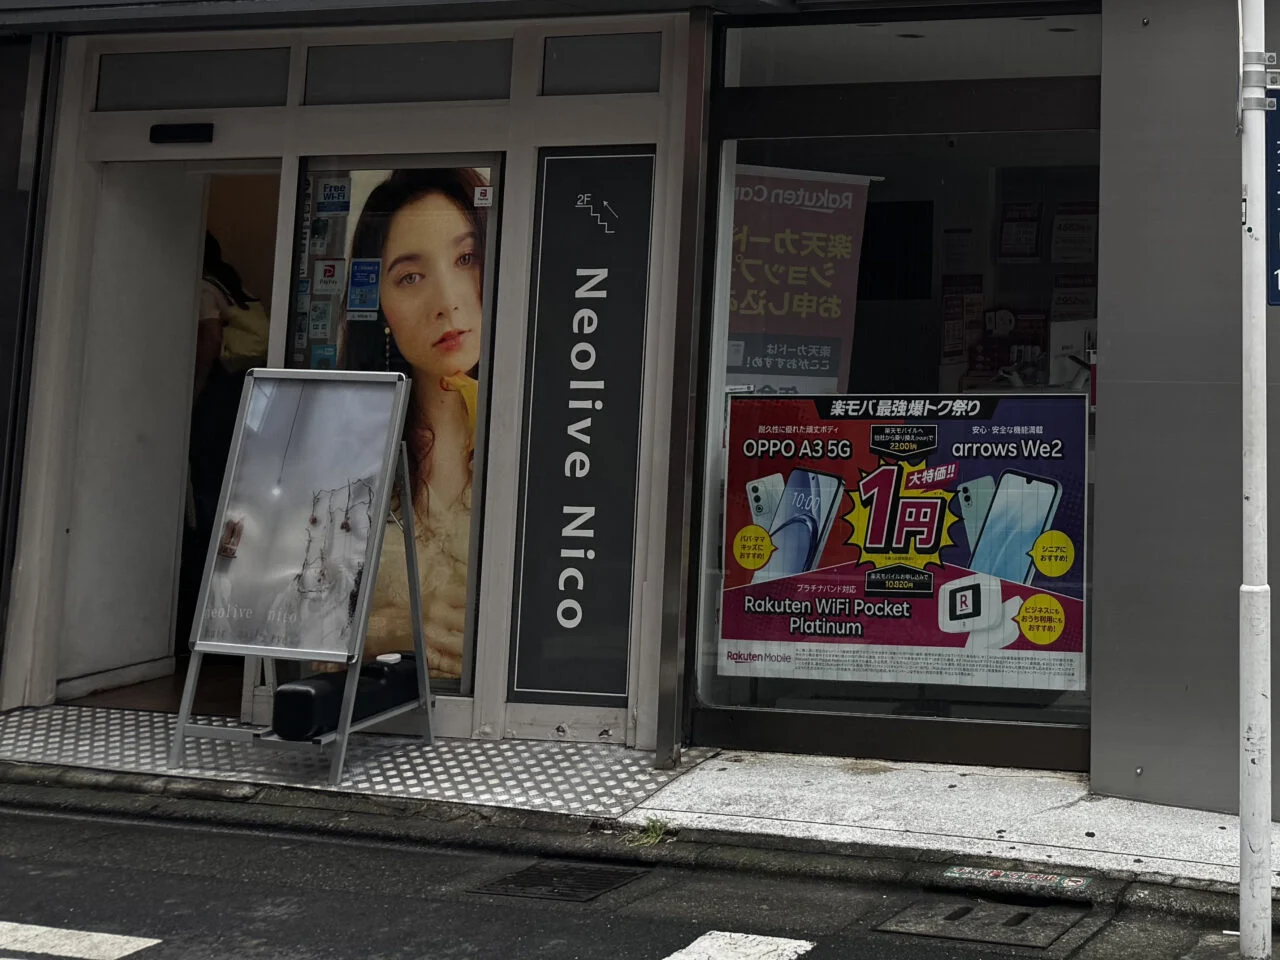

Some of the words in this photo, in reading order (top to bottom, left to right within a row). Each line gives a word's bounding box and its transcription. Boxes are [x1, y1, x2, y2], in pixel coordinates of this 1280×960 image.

[323, 184, 346, 192] Free
[577, 194, 591, 205] 2F
[565, 268, 608, 478] Neolive
[743, 440, 795, 458] OPPO
[799, 440, 823, 458] A3
[827, 440, 850, 458] 5G
[952, 442, 1017, 458] arrows
[1021, 439, 1063, 458] We2
[792, 491, 820, 510] 10:00
[858, 465, 942, 549] 1円
[1041, 545, 1067, 553] シニアに
[556, 506, 596, 628] Nico
[744, 595, 811, 614] Rakuten
[815, 598, 850, 615] WiFi
[854, 599, 910, 617] Pocket
[790, 617, 862, 636] Platinum
[727, 651, 763, 663] Rakuten
[764, 653, 791, 663] Mobile
